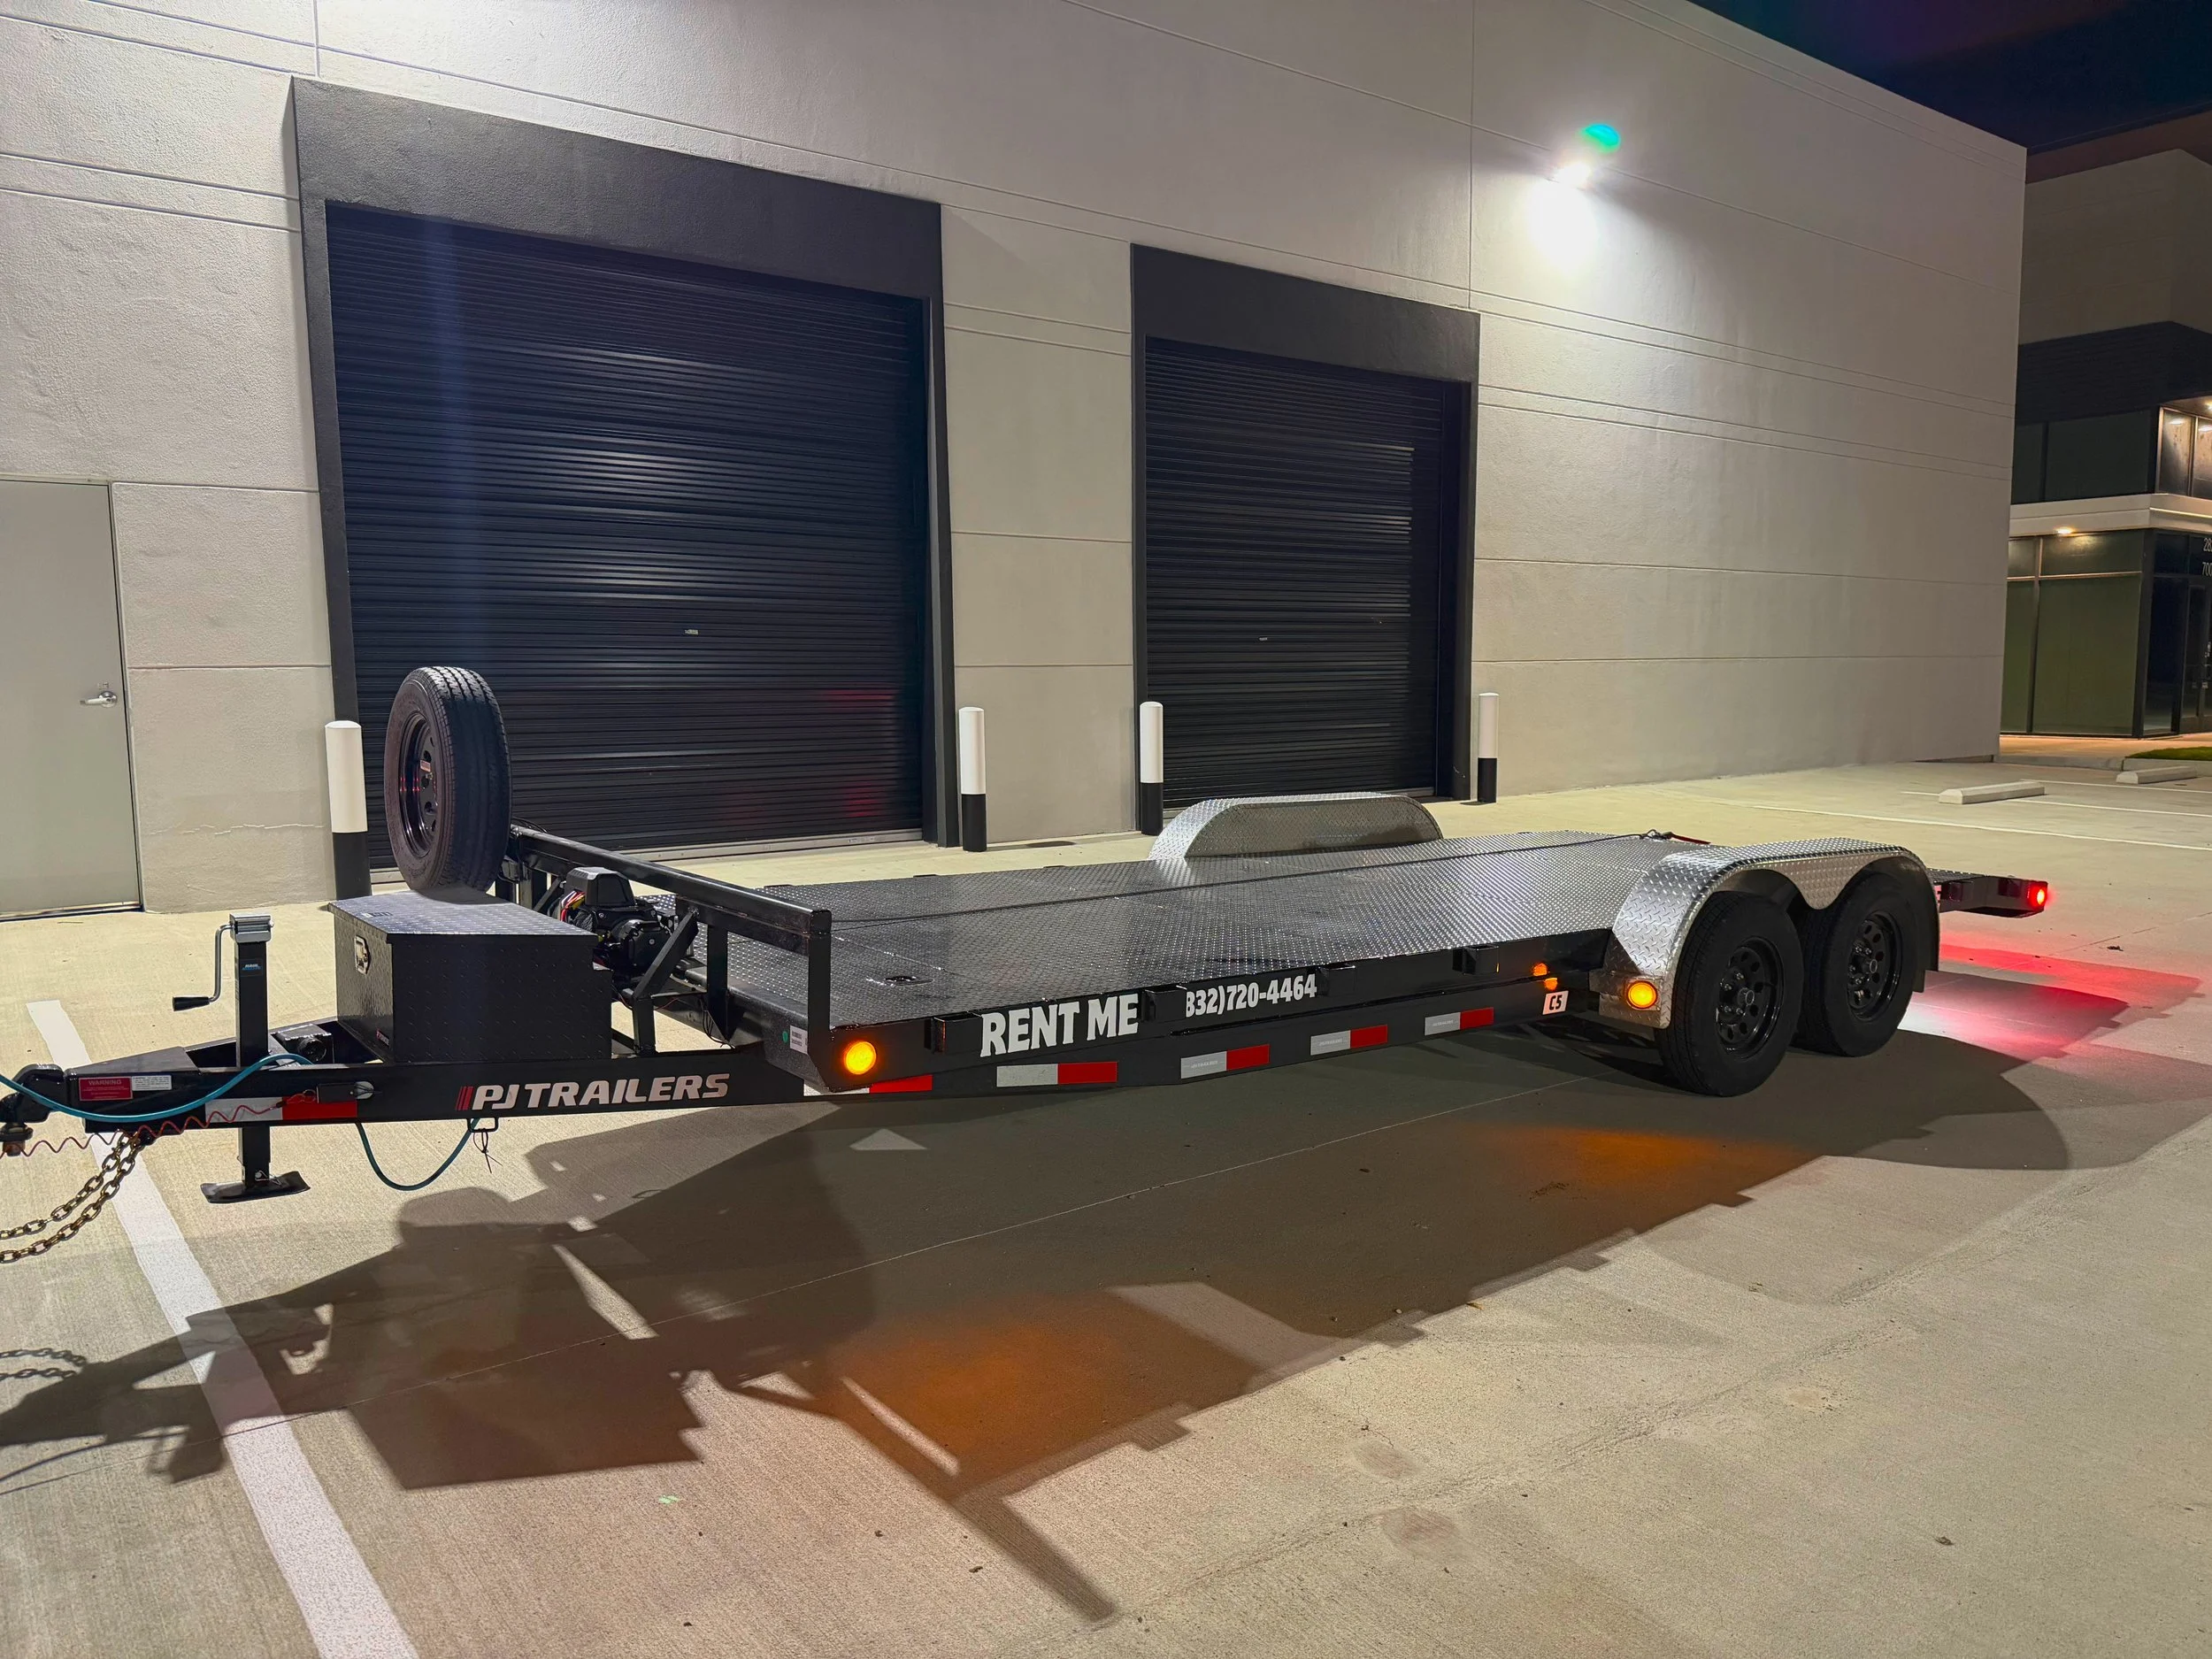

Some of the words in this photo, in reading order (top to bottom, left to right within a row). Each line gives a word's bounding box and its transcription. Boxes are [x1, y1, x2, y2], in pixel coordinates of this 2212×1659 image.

[1548, 994, 1563, 1010] C5
[980, 1001, 1080, 1057] RENT
[1087, 993, 1139, 1041] ME
[524, 1073, 730, 1109] TRAILERS
